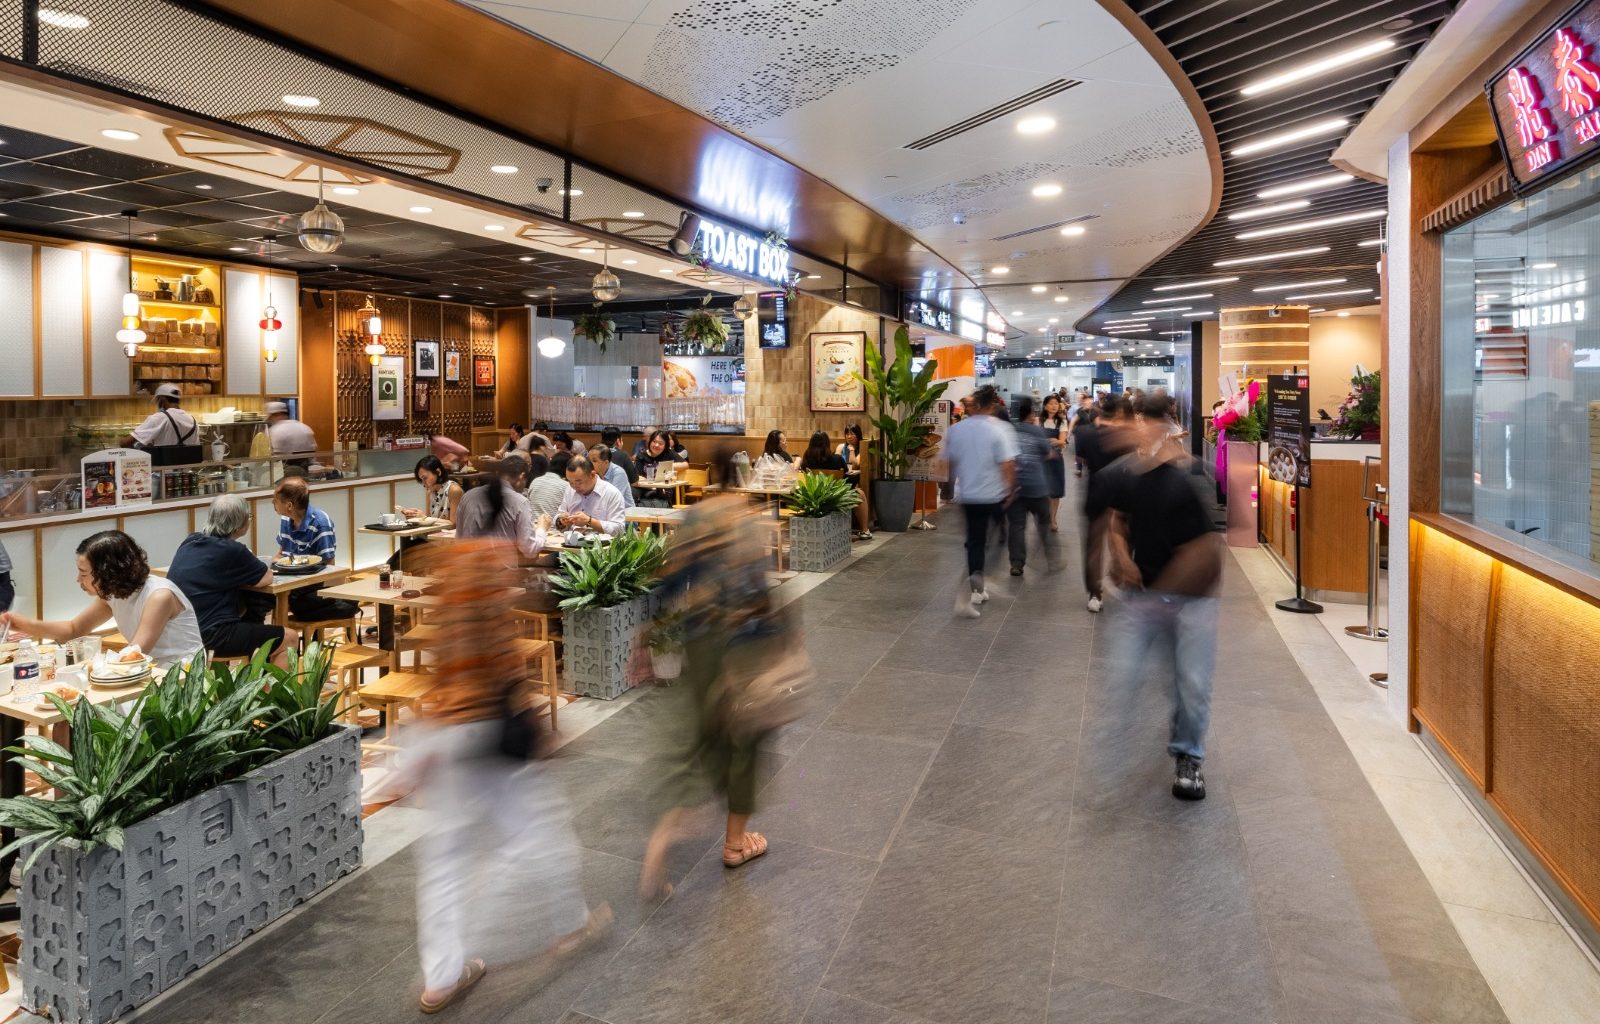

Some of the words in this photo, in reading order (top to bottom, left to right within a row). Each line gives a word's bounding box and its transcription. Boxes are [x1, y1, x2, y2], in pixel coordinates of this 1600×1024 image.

[1528, 141, 1552, 173] DIN
[700, 219, 758, 273] TOAST
[758, 242, 789, 283] BOX
[711, 361, 727, 370] HERE
[711, 373, 723, 382] THE
[912, 417, 939, 425] AFFLE
